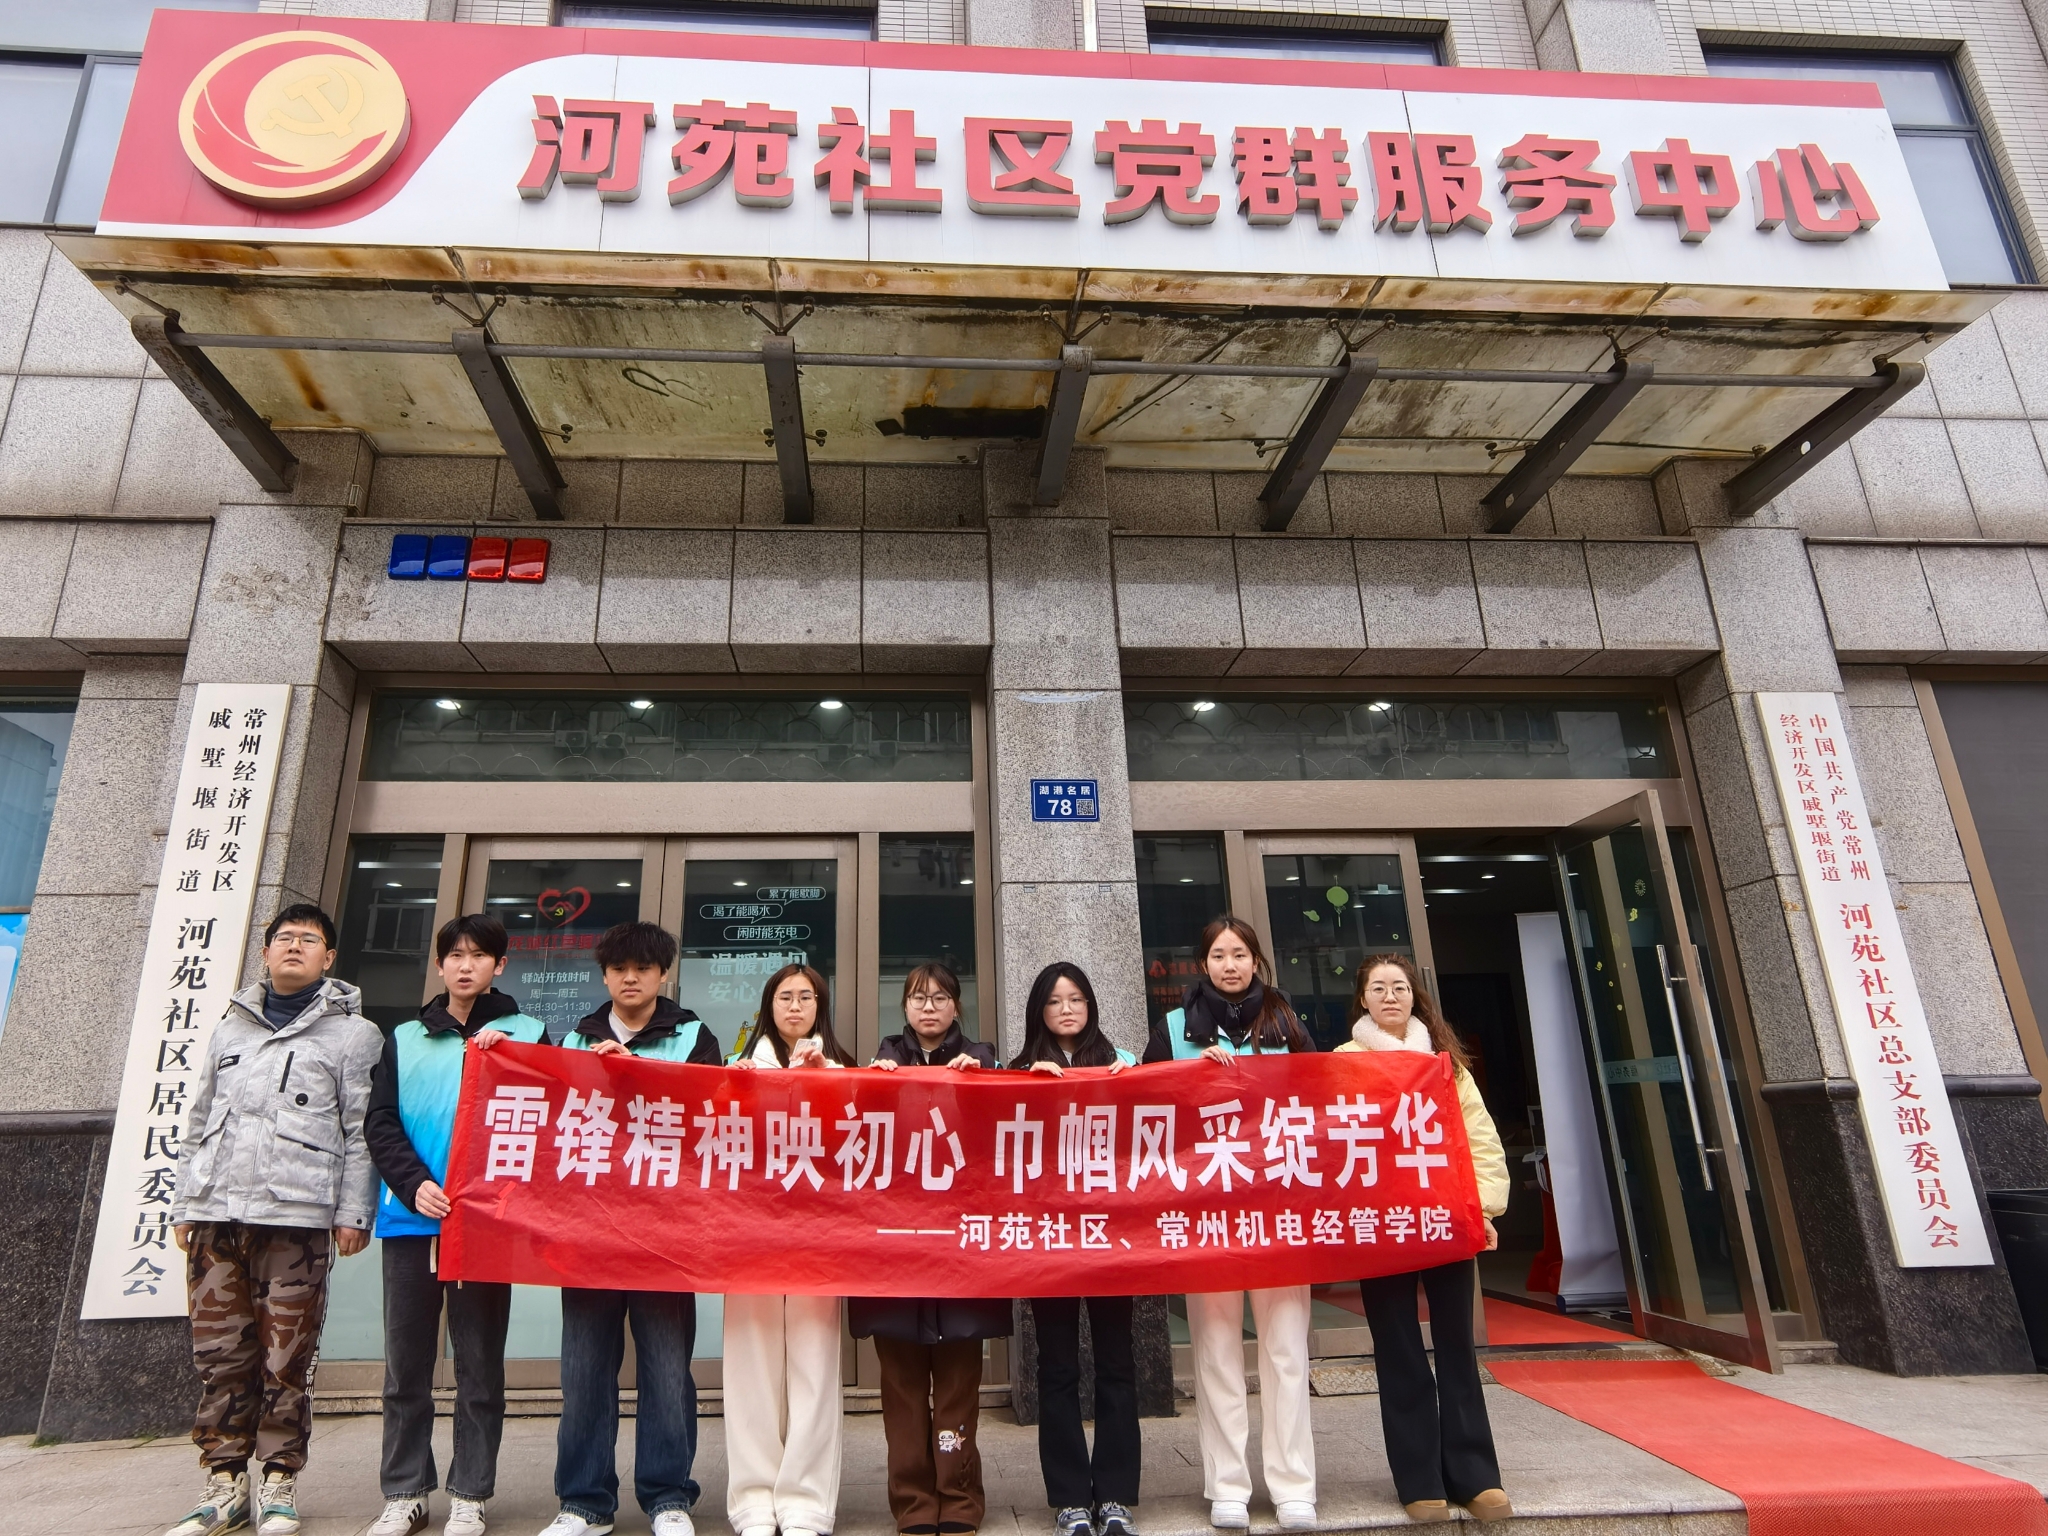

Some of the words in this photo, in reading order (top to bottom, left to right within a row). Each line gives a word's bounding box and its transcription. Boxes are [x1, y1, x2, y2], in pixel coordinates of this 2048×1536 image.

[516, 95, 1881, 243] 河苑社区党群服务中心
[176, 707, 233, 893] 戚墅堰街道
[212, 707, 268, 892] 常州经济开发区
[1039, 785, 1091, 796] 湖港名居
[1047, 799, 1073, 816] 78
[1779, 713, 1842, 882] 经济开发区戚墅堰街道
[1808, 713, 1871, 881] 中国共产党常州
[712, 905, 771, 917] 渴了能喝水
[737, 926, 798, 940] 闲时能充电
[769, 888, 821, 899] 累了能歇脚
[521, 971, 591, 984] 驿站开放时间
[708, 980, 766, 1004] 安心
[121, 916, 219, 1297] 河苑社区居民委员会
[1839, 902, 1961, 1249] 河苑社区总支部委员会
[484, 1085, 966, 1192] 雷锋精神映初心
[994, 1091, 1449, 1195] 巾帼风采绽芳华
